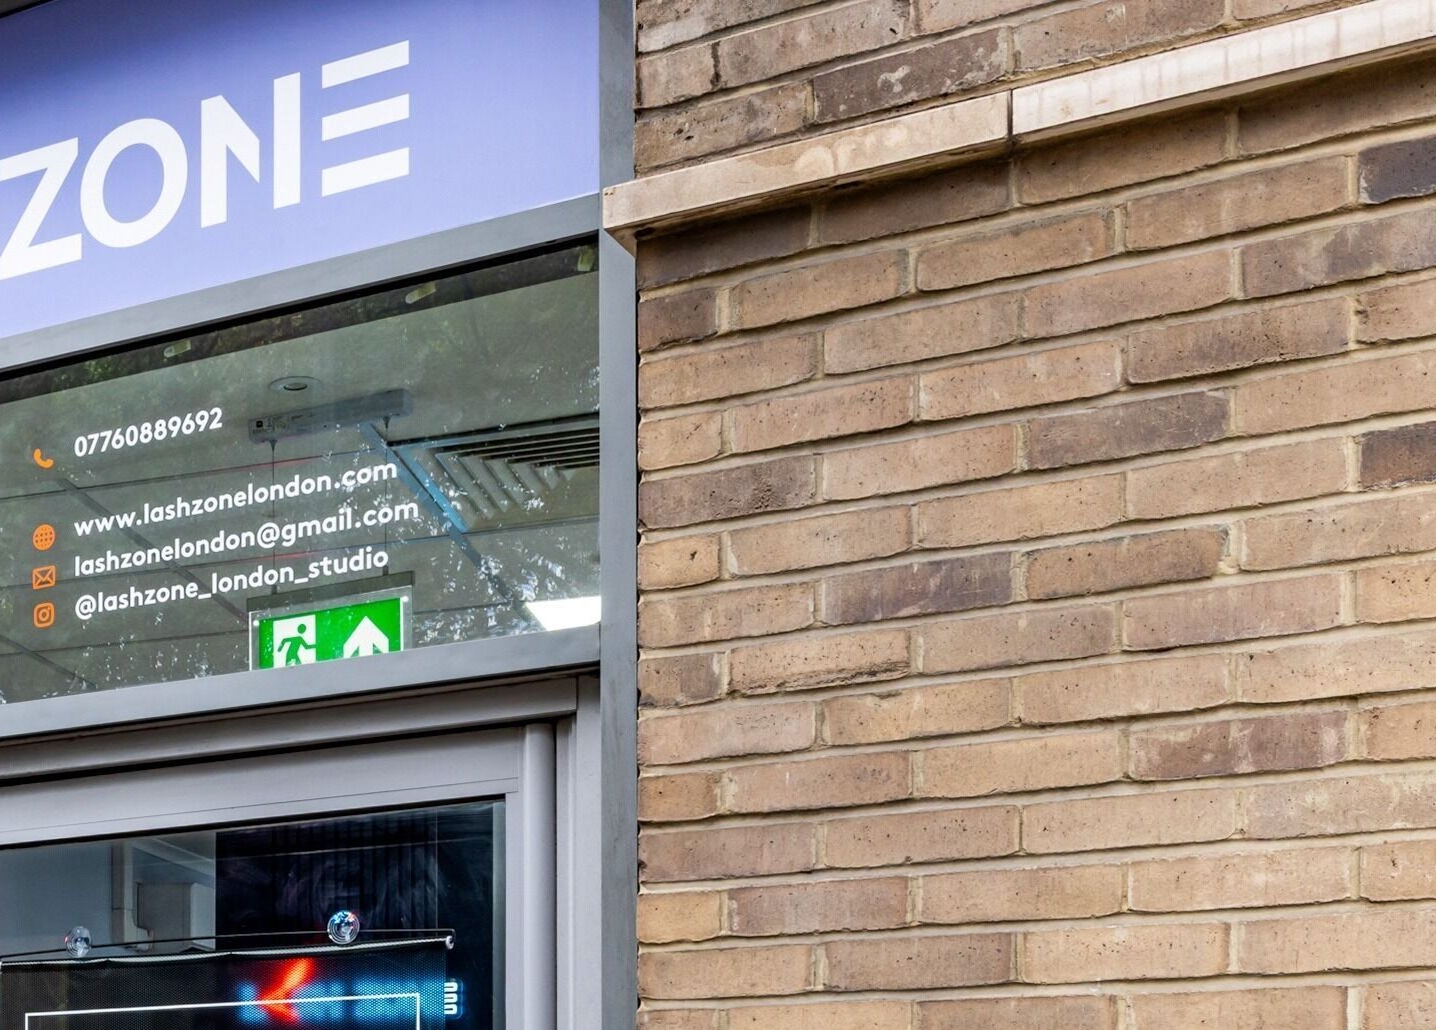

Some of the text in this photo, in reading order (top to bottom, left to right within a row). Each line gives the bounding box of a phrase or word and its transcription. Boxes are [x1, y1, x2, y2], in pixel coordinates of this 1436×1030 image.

[73, 407, 223, 458] 07760889692
[74, 462, 398, 537] www.lashzonelondon.com
[74, 503, 419, 577] lashzonelondon@gmail.com
[74, 546, 389, 622] @lashzone_london_studio
